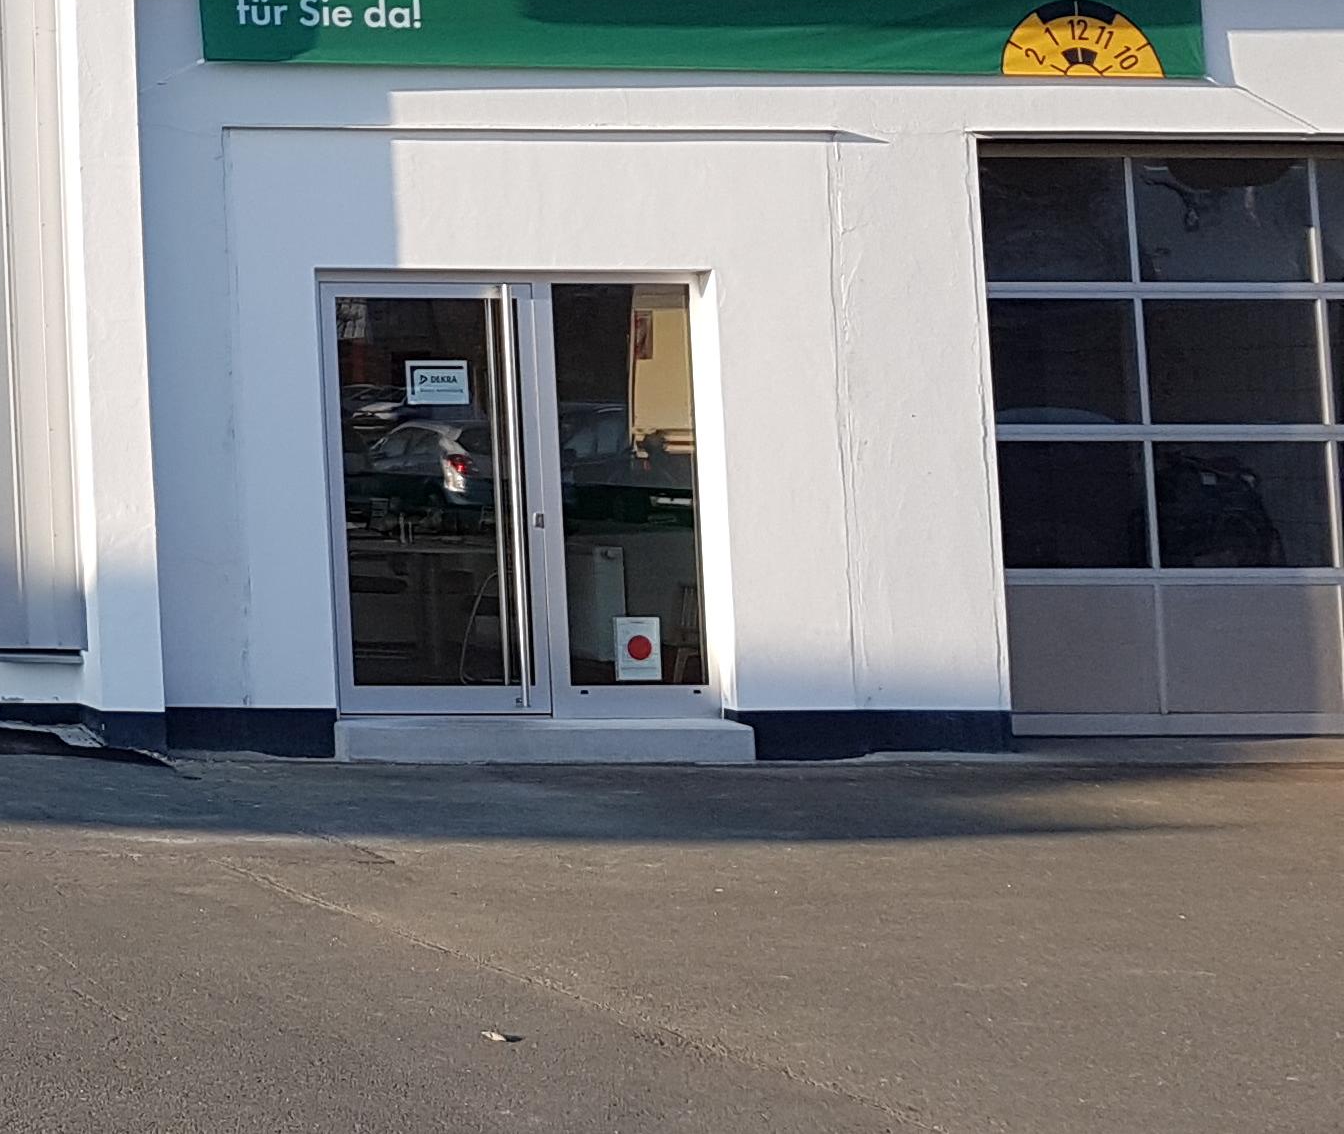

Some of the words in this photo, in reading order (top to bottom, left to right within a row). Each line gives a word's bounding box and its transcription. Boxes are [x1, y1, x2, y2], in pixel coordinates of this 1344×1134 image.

[1044, 26, 1059, 46] 1
[1067, 19, 1090, 41] 12
[1095, 26, 1114, 50] 11
[1024, 48, 1046, 65] 2
[1114, 45, 1138, 71] 10
